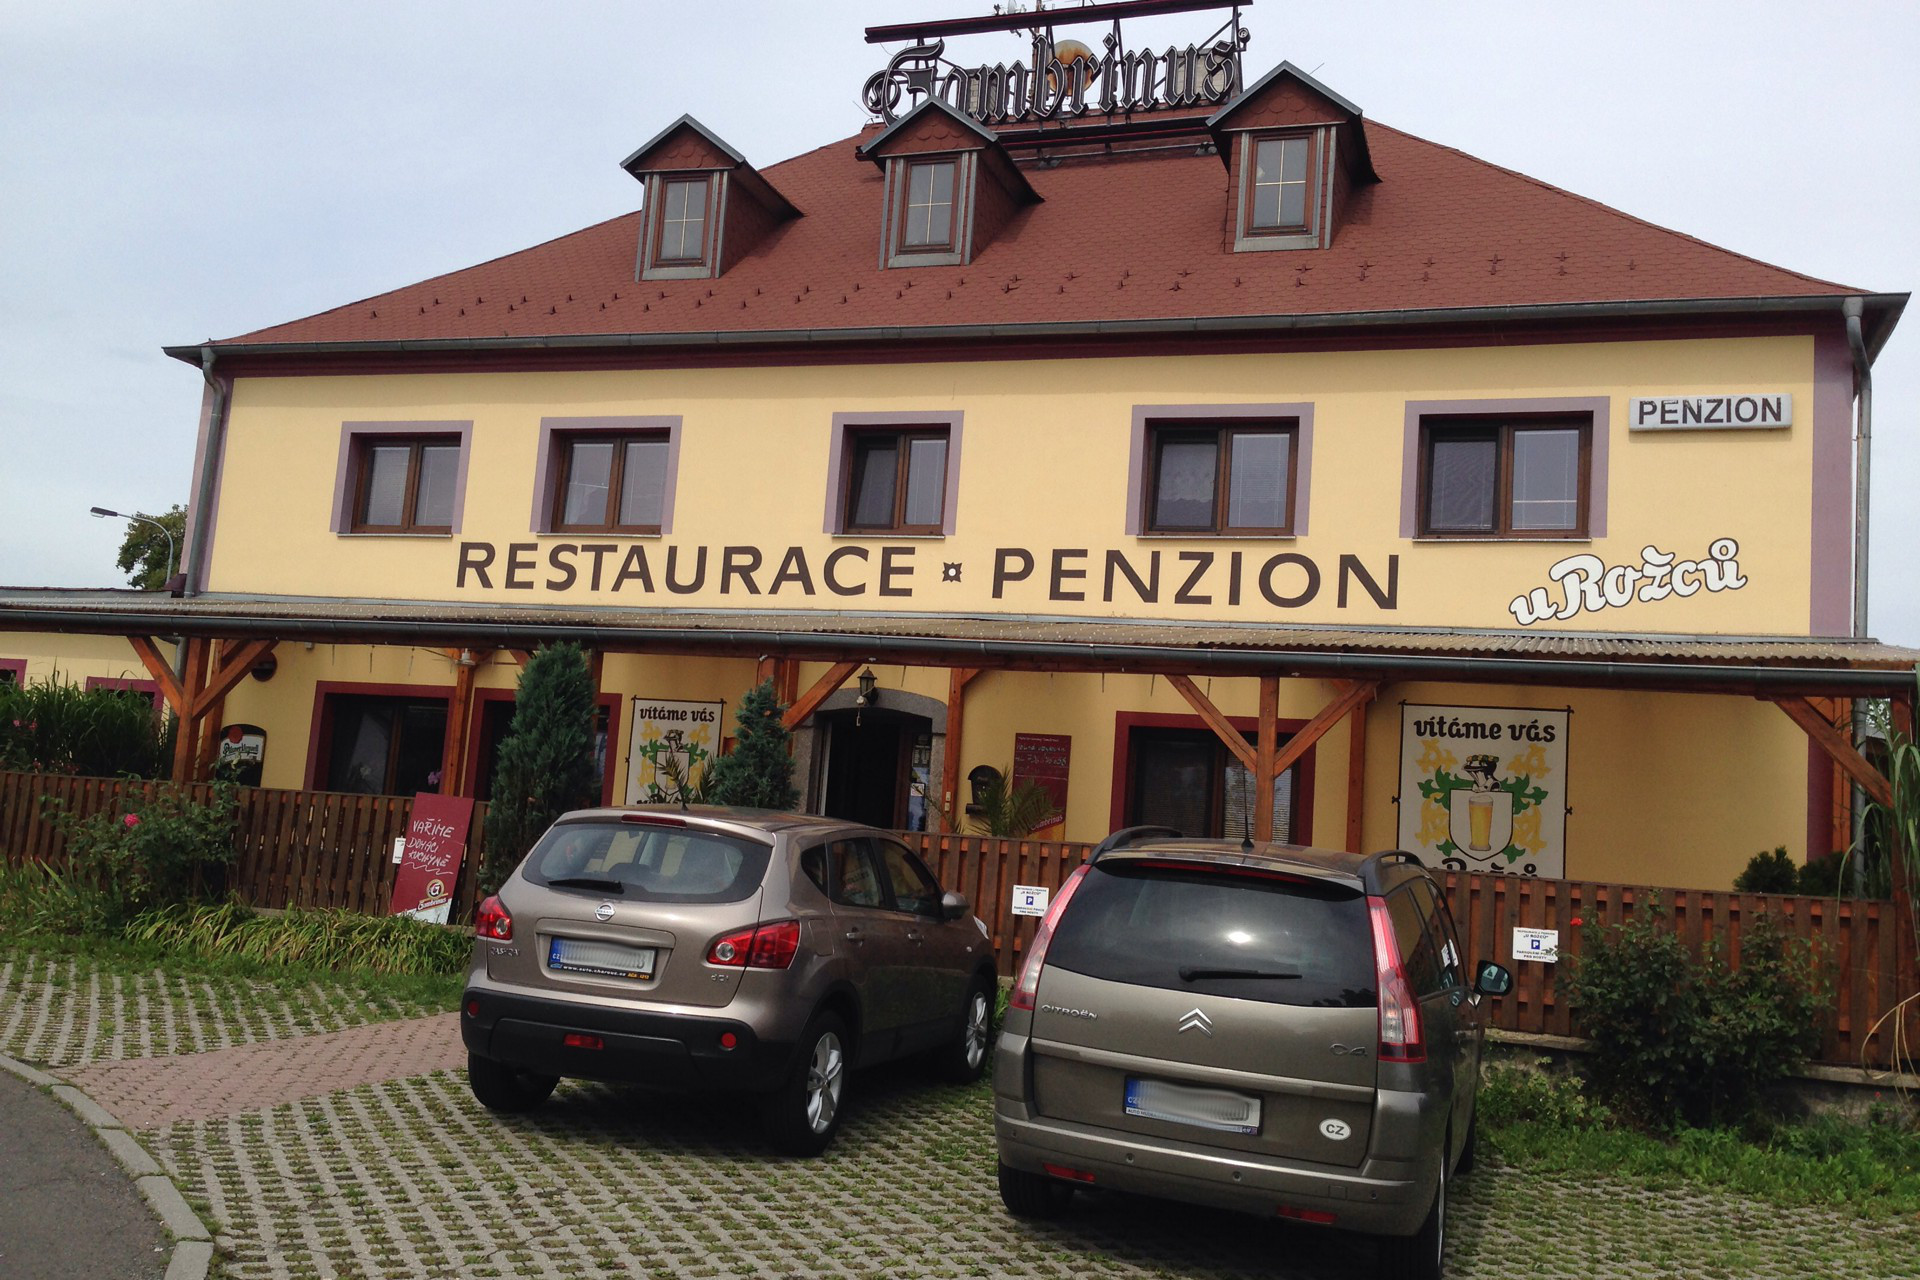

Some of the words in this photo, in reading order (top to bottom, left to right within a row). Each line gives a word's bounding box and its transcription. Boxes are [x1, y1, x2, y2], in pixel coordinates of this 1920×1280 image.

[862, 33, 1236, 127] Gambrinus
[1638, 397, 1782, 425] PENZION
[456, 542, 916, 598] RESTAURACE
[992, 547, 1400, 610] PENZION
[639, 706, 687, 721] vítáme
[690, 707, 715, 722] vás
[1413, 716, 1502, 740] vítáme
[1508, 719, 1556, 743] vás
[413, 818, 455, 838] VAŘÍME
[1041, 1004, 1098, 1020] CITROËN
[1326, 1123, 1345, 1136] CZ
